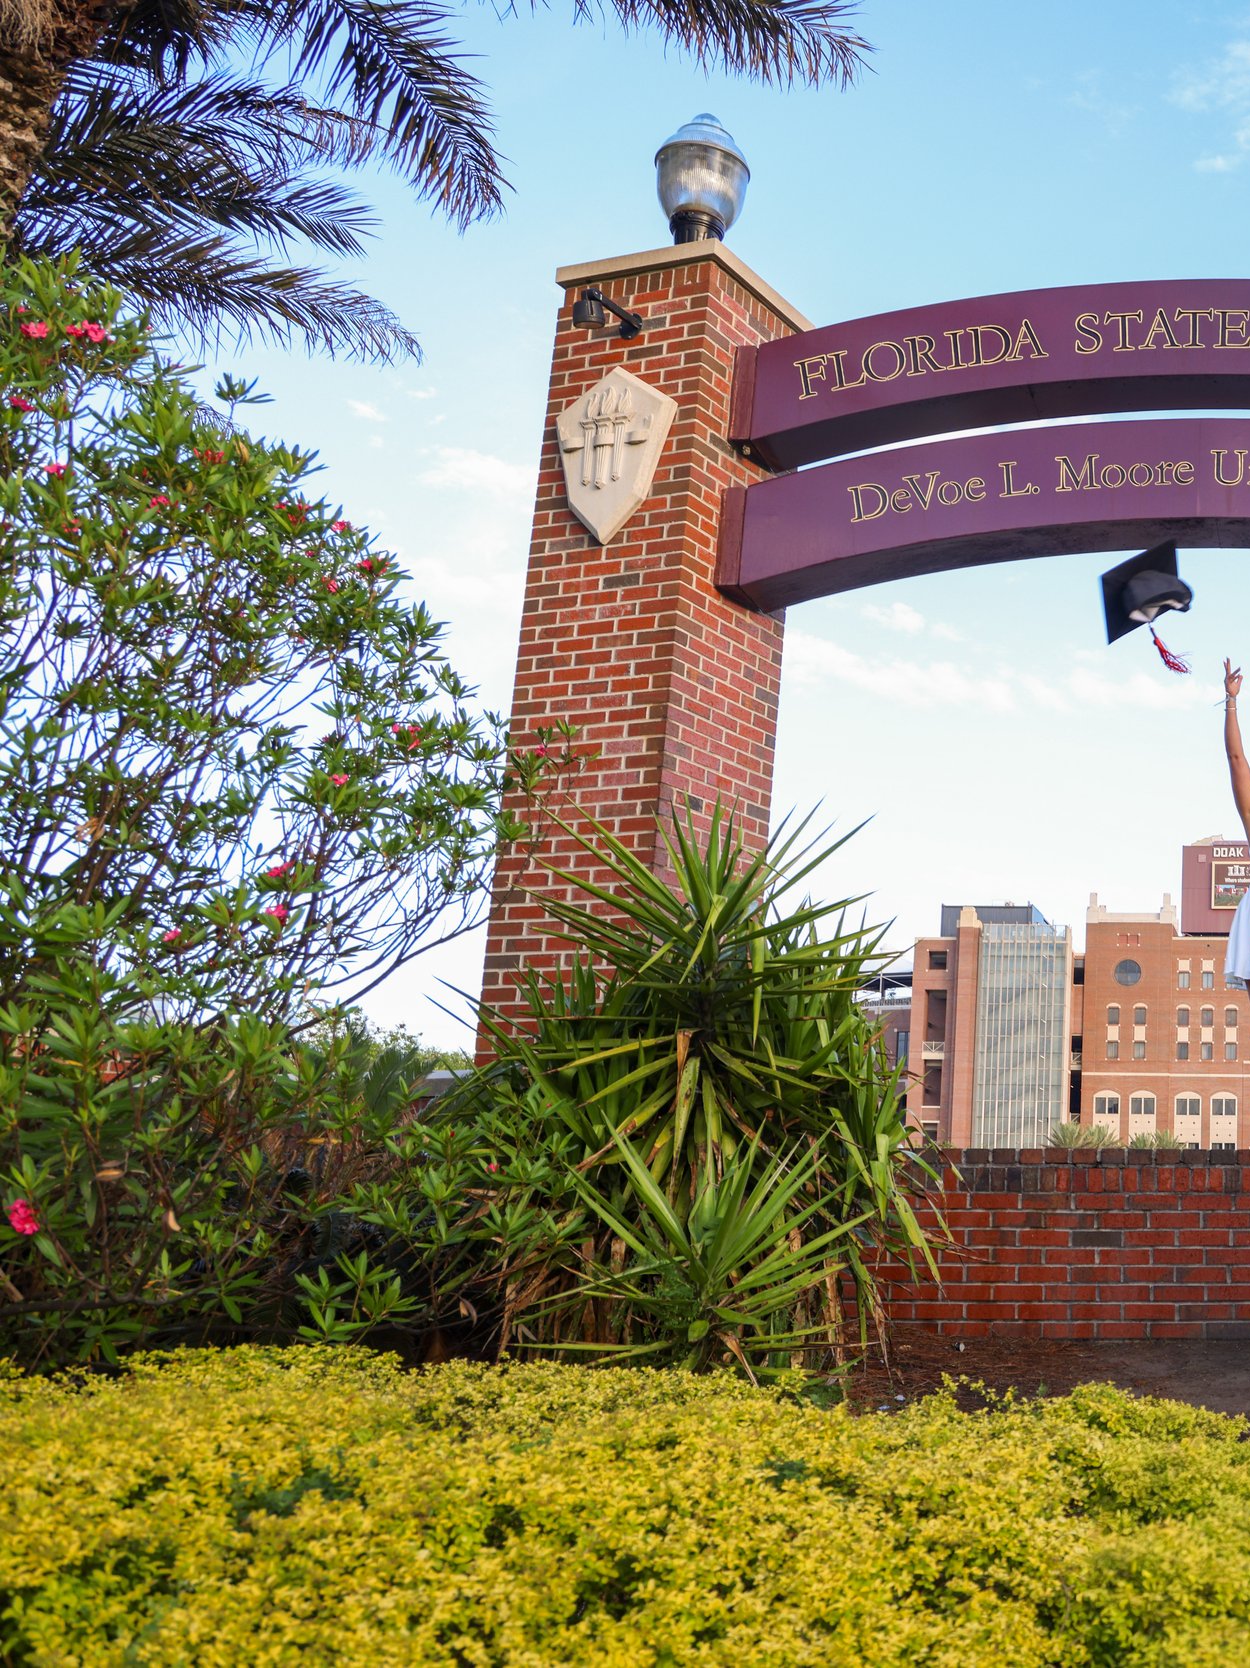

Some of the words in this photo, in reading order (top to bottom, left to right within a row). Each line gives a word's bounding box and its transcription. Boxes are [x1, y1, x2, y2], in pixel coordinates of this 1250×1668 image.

[793, 319, 1049, 400] FLORIDA
[847, 471, 986, 523] DeVoe
[999, 461, 1040, 498] L.
[1055, 453, 1193, 492] Moore
[1213, 847, 1244, 858] DOAK
